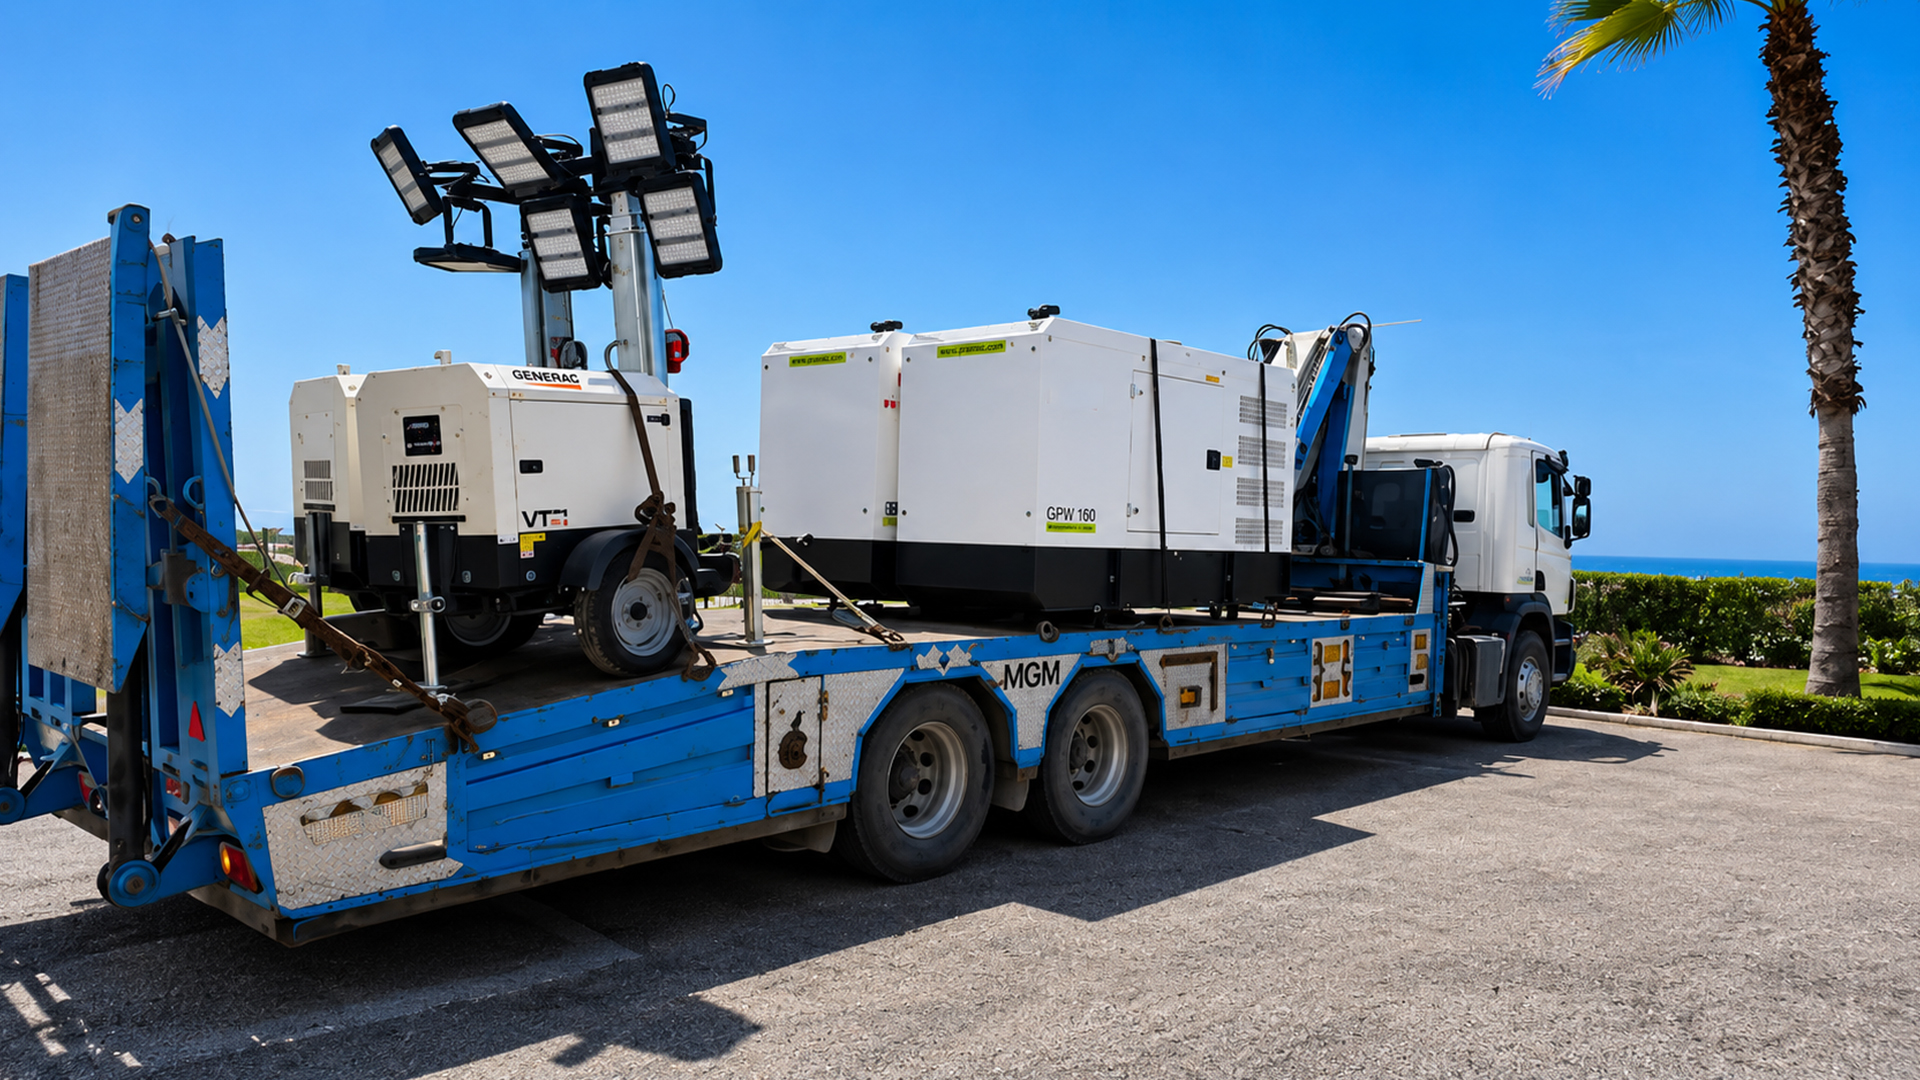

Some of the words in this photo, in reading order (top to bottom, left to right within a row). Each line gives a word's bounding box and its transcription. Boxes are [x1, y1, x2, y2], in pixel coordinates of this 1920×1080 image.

[512, 369, 580, 384] GENERAC
[1046, 506, 1075, 521] GPW
[1077, 508, 1096, 522] 160
[1003, 660, 1060, 690] MGM
